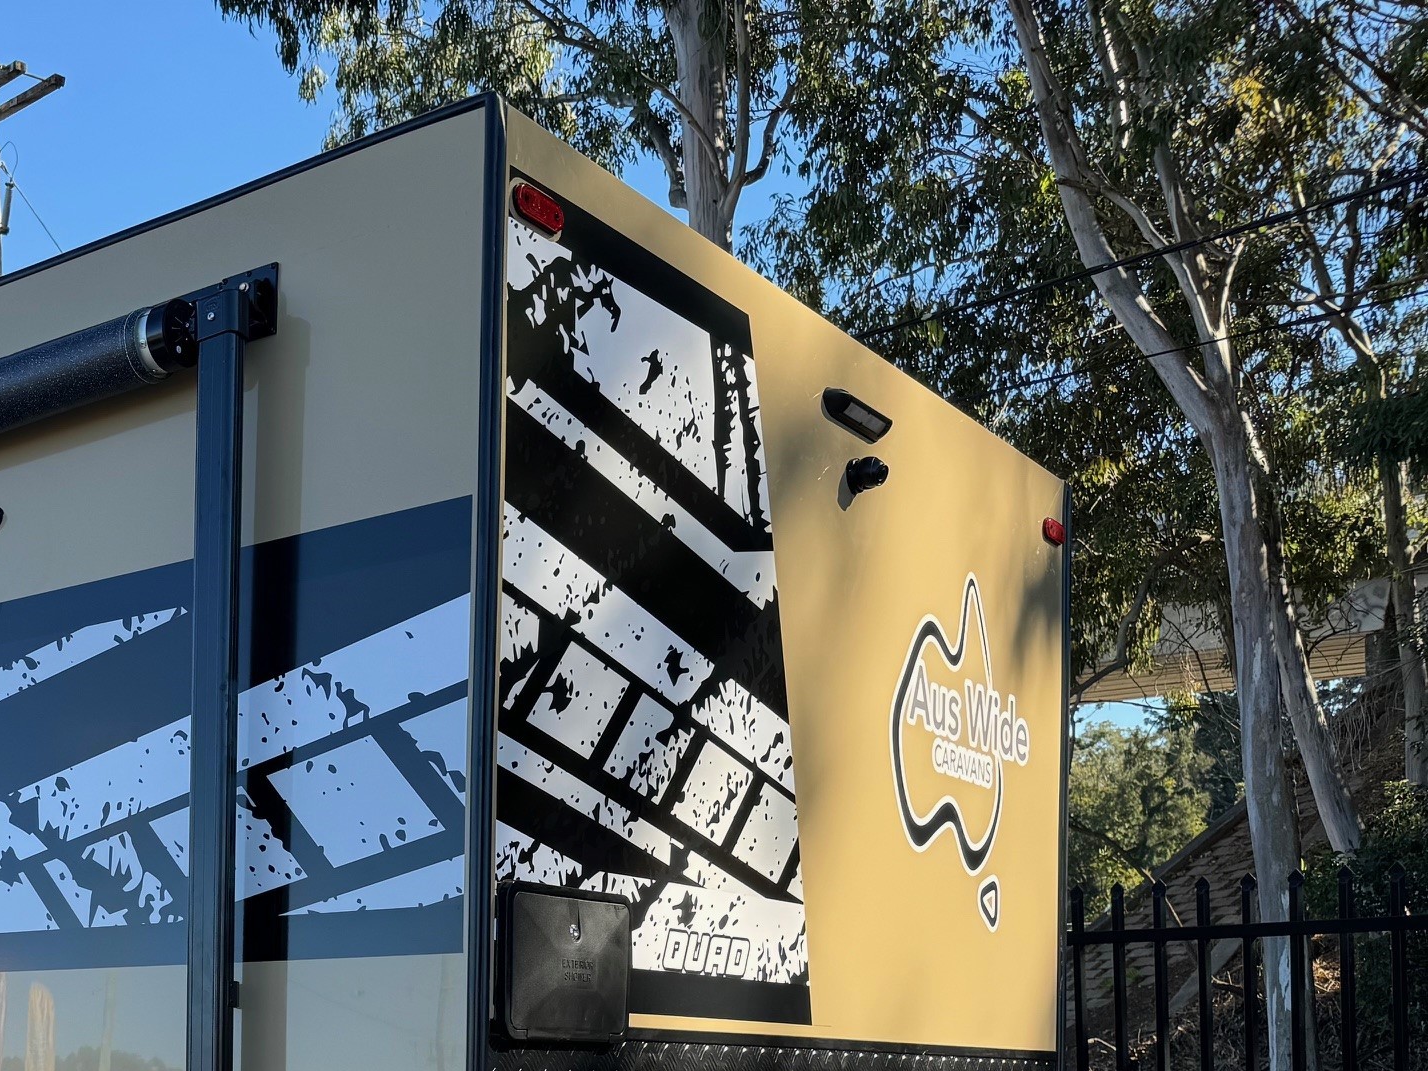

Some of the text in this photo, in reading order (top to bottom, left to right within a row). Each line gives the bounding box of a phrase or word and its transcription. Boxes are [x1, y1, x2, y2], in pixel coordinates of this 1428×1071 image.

[909, 662, 1028, 764] Aus Wide
[933, 741, 992, 786] CARAVANS
[662, 928, 750, 977] QUAD
